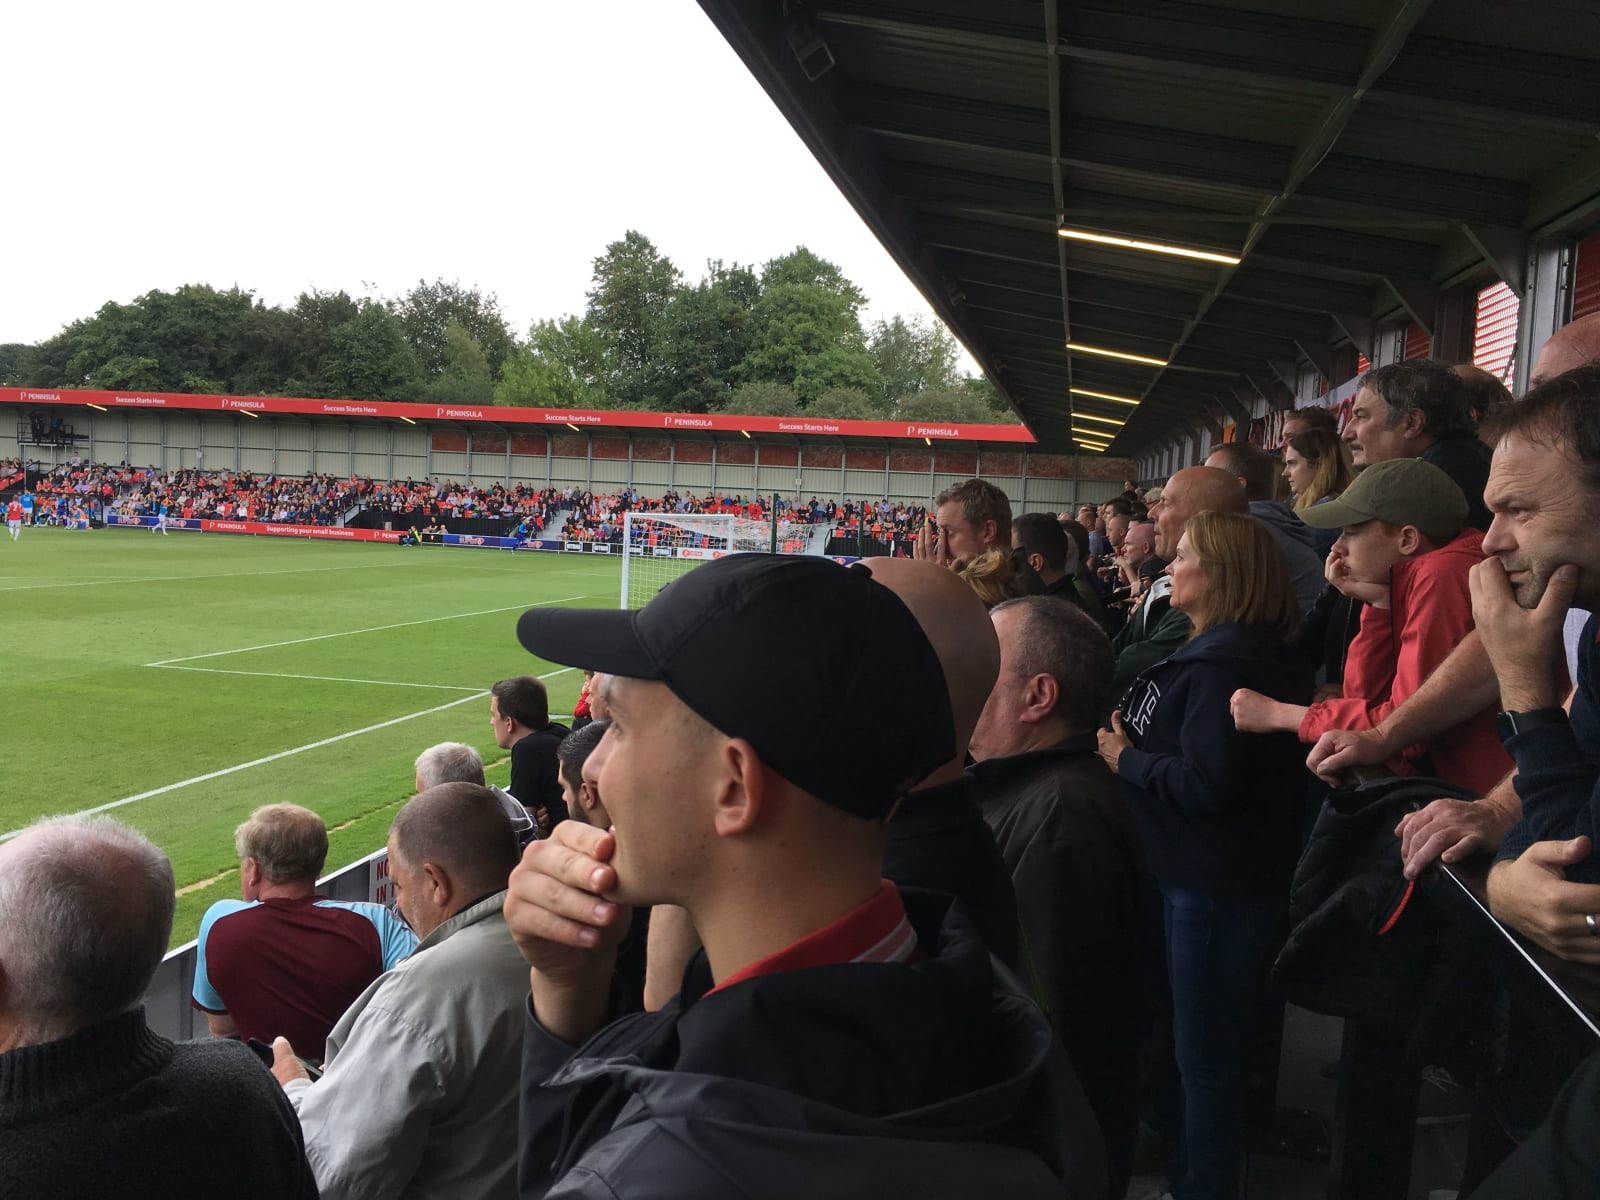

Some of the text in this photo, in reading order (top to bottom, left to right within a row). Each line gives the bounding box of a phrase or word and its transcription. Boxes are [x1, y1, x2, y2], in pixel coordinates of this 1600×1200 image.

[28, 393, 61, 401] PENINSULA
[231, 400, 265, 408] PENINSULA
[323, 404, 345, 412] Success
[446, 409, 483, 418] PENINSULA
[545, 413, 568, 421] Success
[568, 414, 586, 422] Starts
[674, 418, 713, 427] PENINSULA
[779, 422, 839, 432] Success Starts Here
[917, 427, 959, 436] PENINSULA
[266, 525, 354, 537] Supporting your small business
